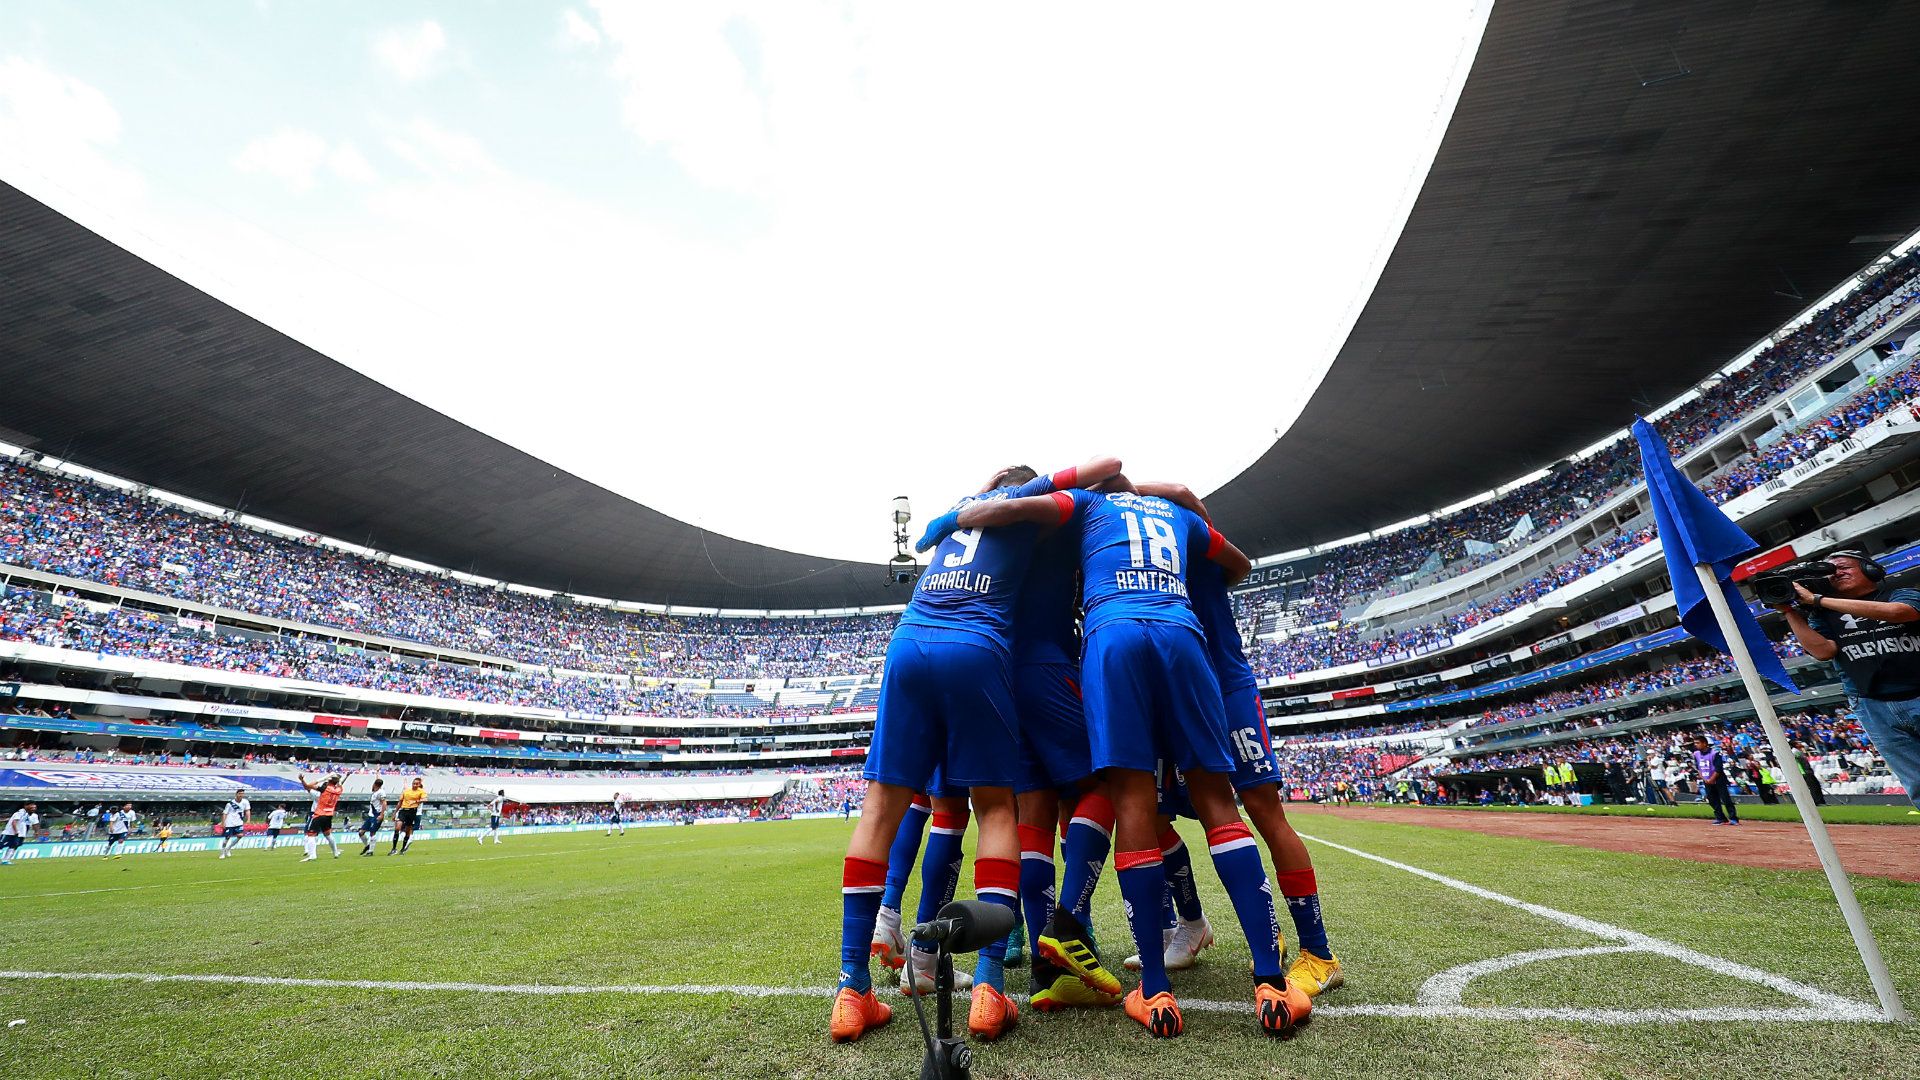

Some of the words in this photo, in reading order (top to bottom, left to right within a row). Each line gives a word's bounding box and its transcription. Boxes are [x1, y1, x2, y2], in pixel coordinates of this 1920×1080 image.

[943, 526, 985, 567] 9
[1120, 511, 1181, 574] 18
[920, 570, 991, 593] CARAGLIO
[404, 723, 427, 732] Corona
[431, 725, 452, 734] Corona
[1230, 727, 1265, 763] 16
[50, 843, 110, 858] MACRONE
